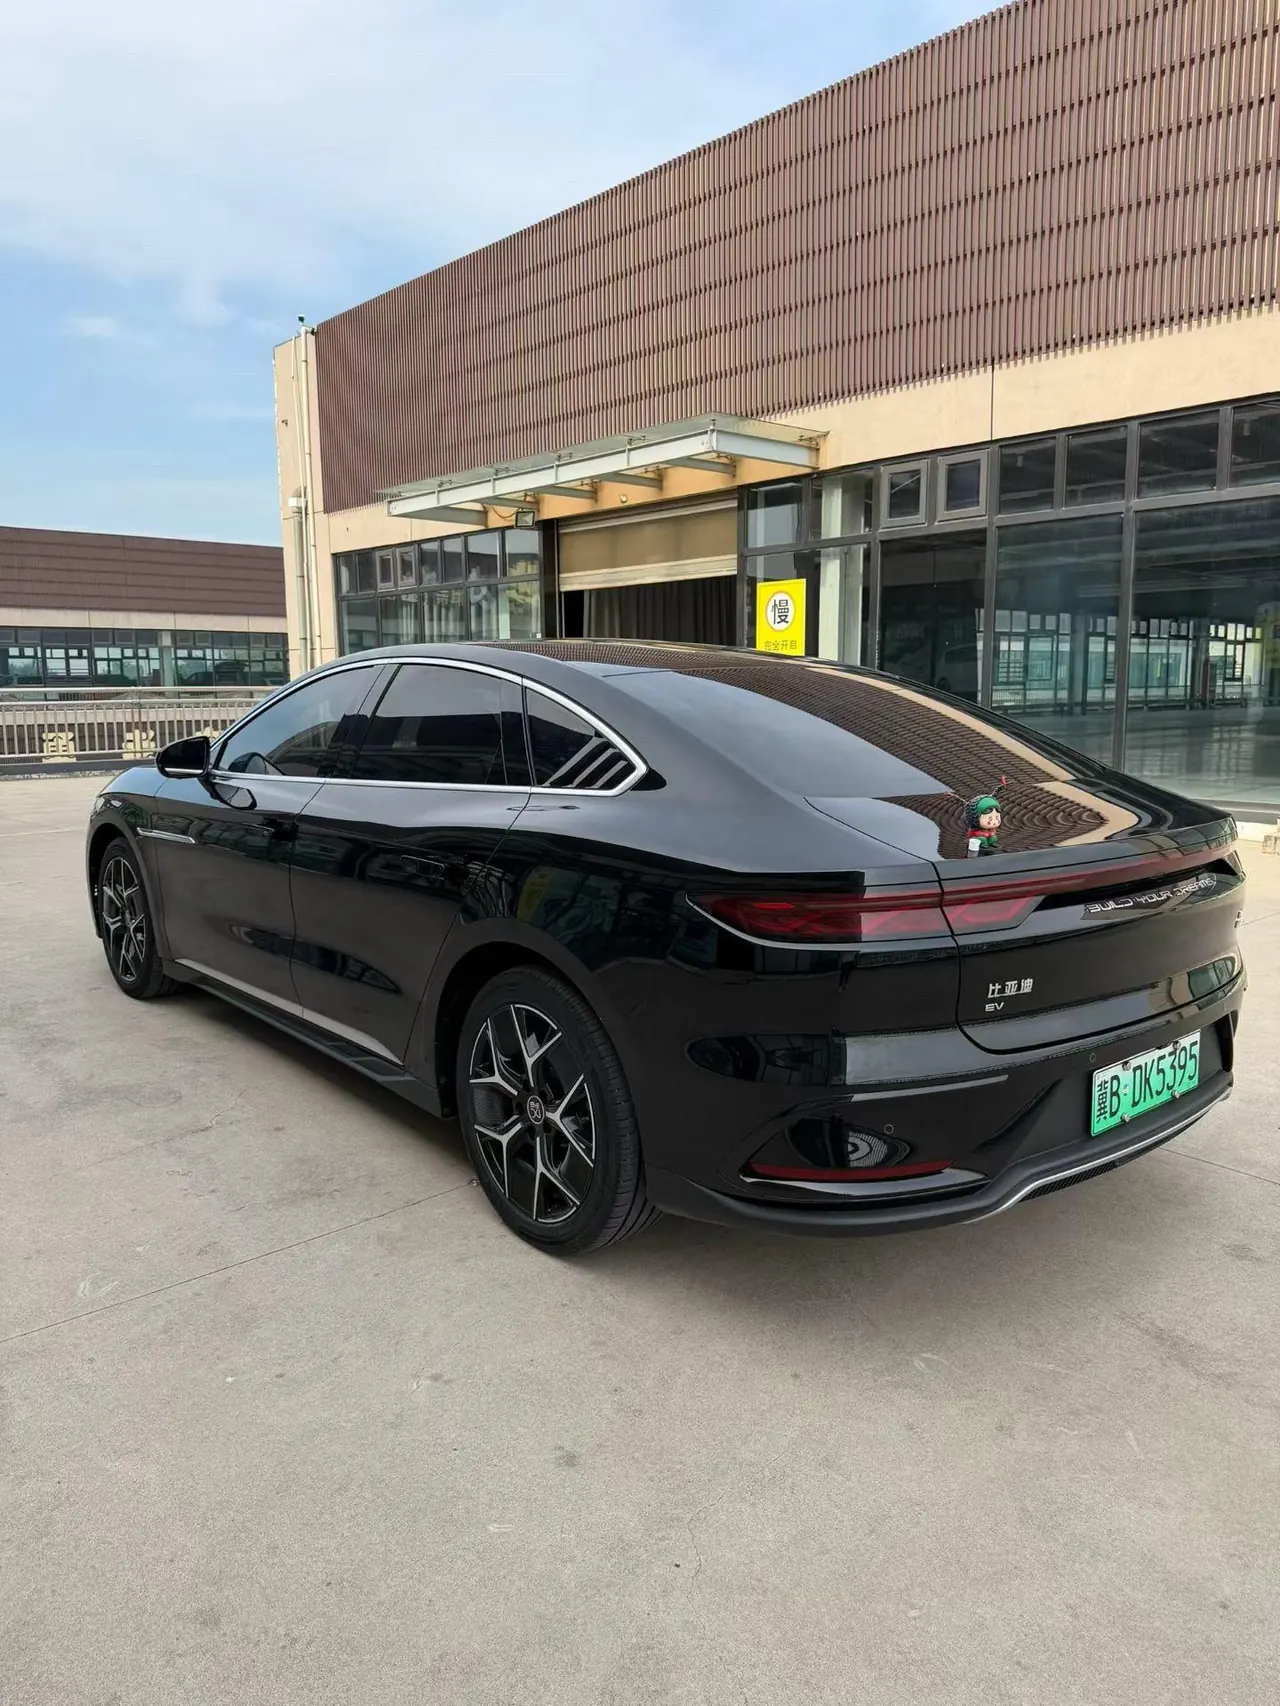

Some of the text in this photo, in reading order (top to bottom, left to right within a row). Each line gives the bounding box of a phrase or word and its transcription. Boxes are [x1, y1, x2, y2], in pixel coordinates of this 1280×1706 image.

[771, 598, 790, 625] 慢
[987, 977, 1034, 999] 比亚迪
[985, 1002, 1005, 1012] EV
